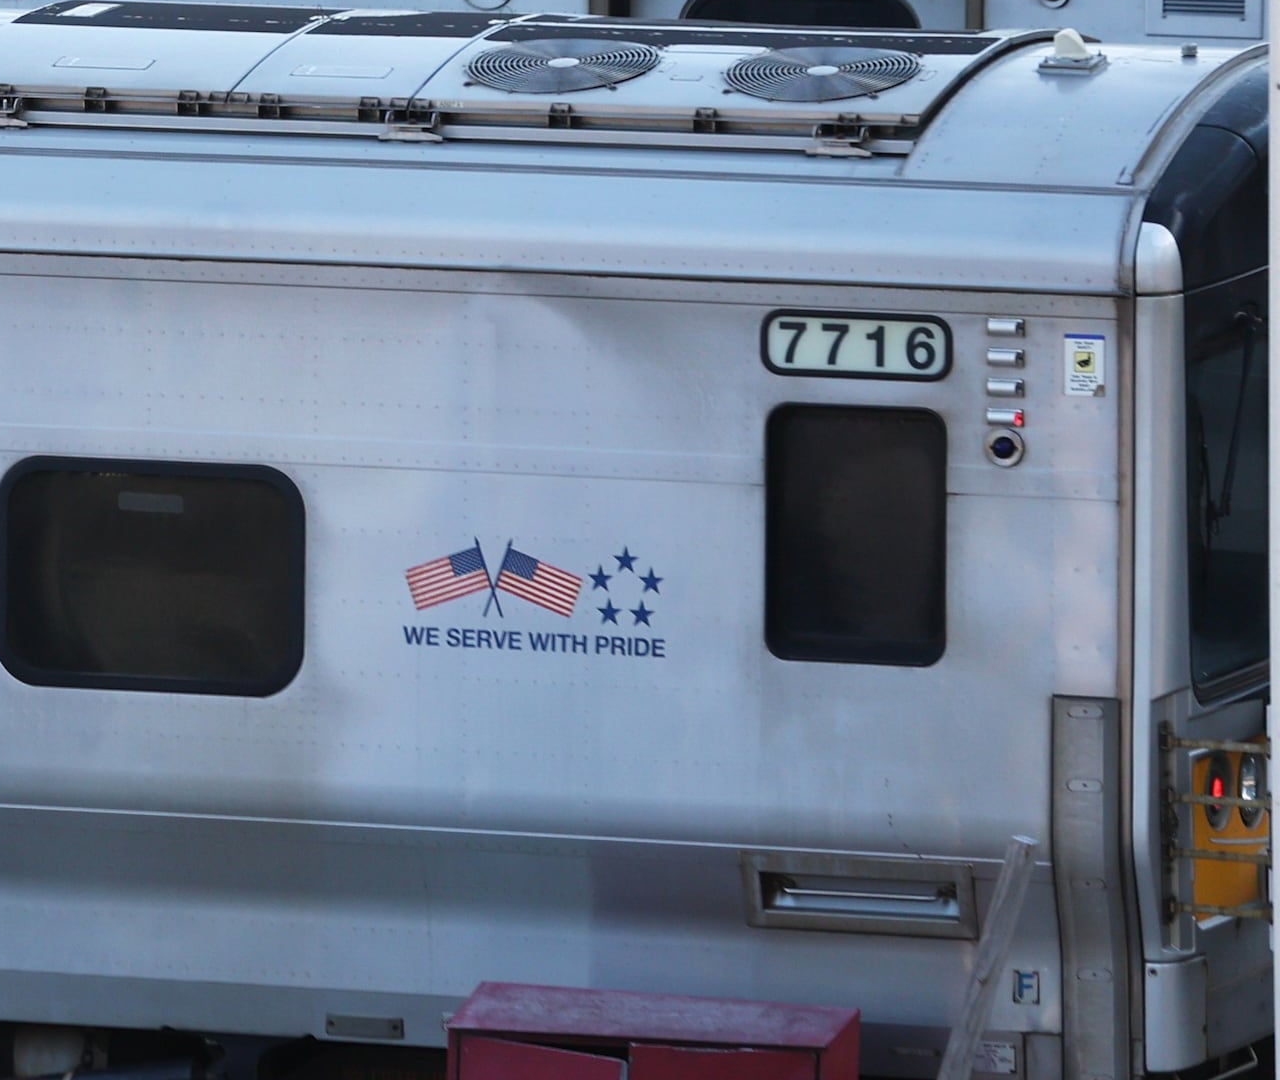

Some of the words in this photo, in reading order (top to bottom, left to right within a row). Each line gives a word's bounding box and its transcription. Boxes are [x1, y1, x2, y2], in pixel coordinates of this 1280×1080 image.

[778, 320, 937, 371] 7716
[403, 625, 439, 646] WE
[446, 628, 522, 651] SERVE
[529, 632, 588, 654] WITH
[595, 636, 666, 658] PRIDE
[1017, 972, 1035, 1000] F
